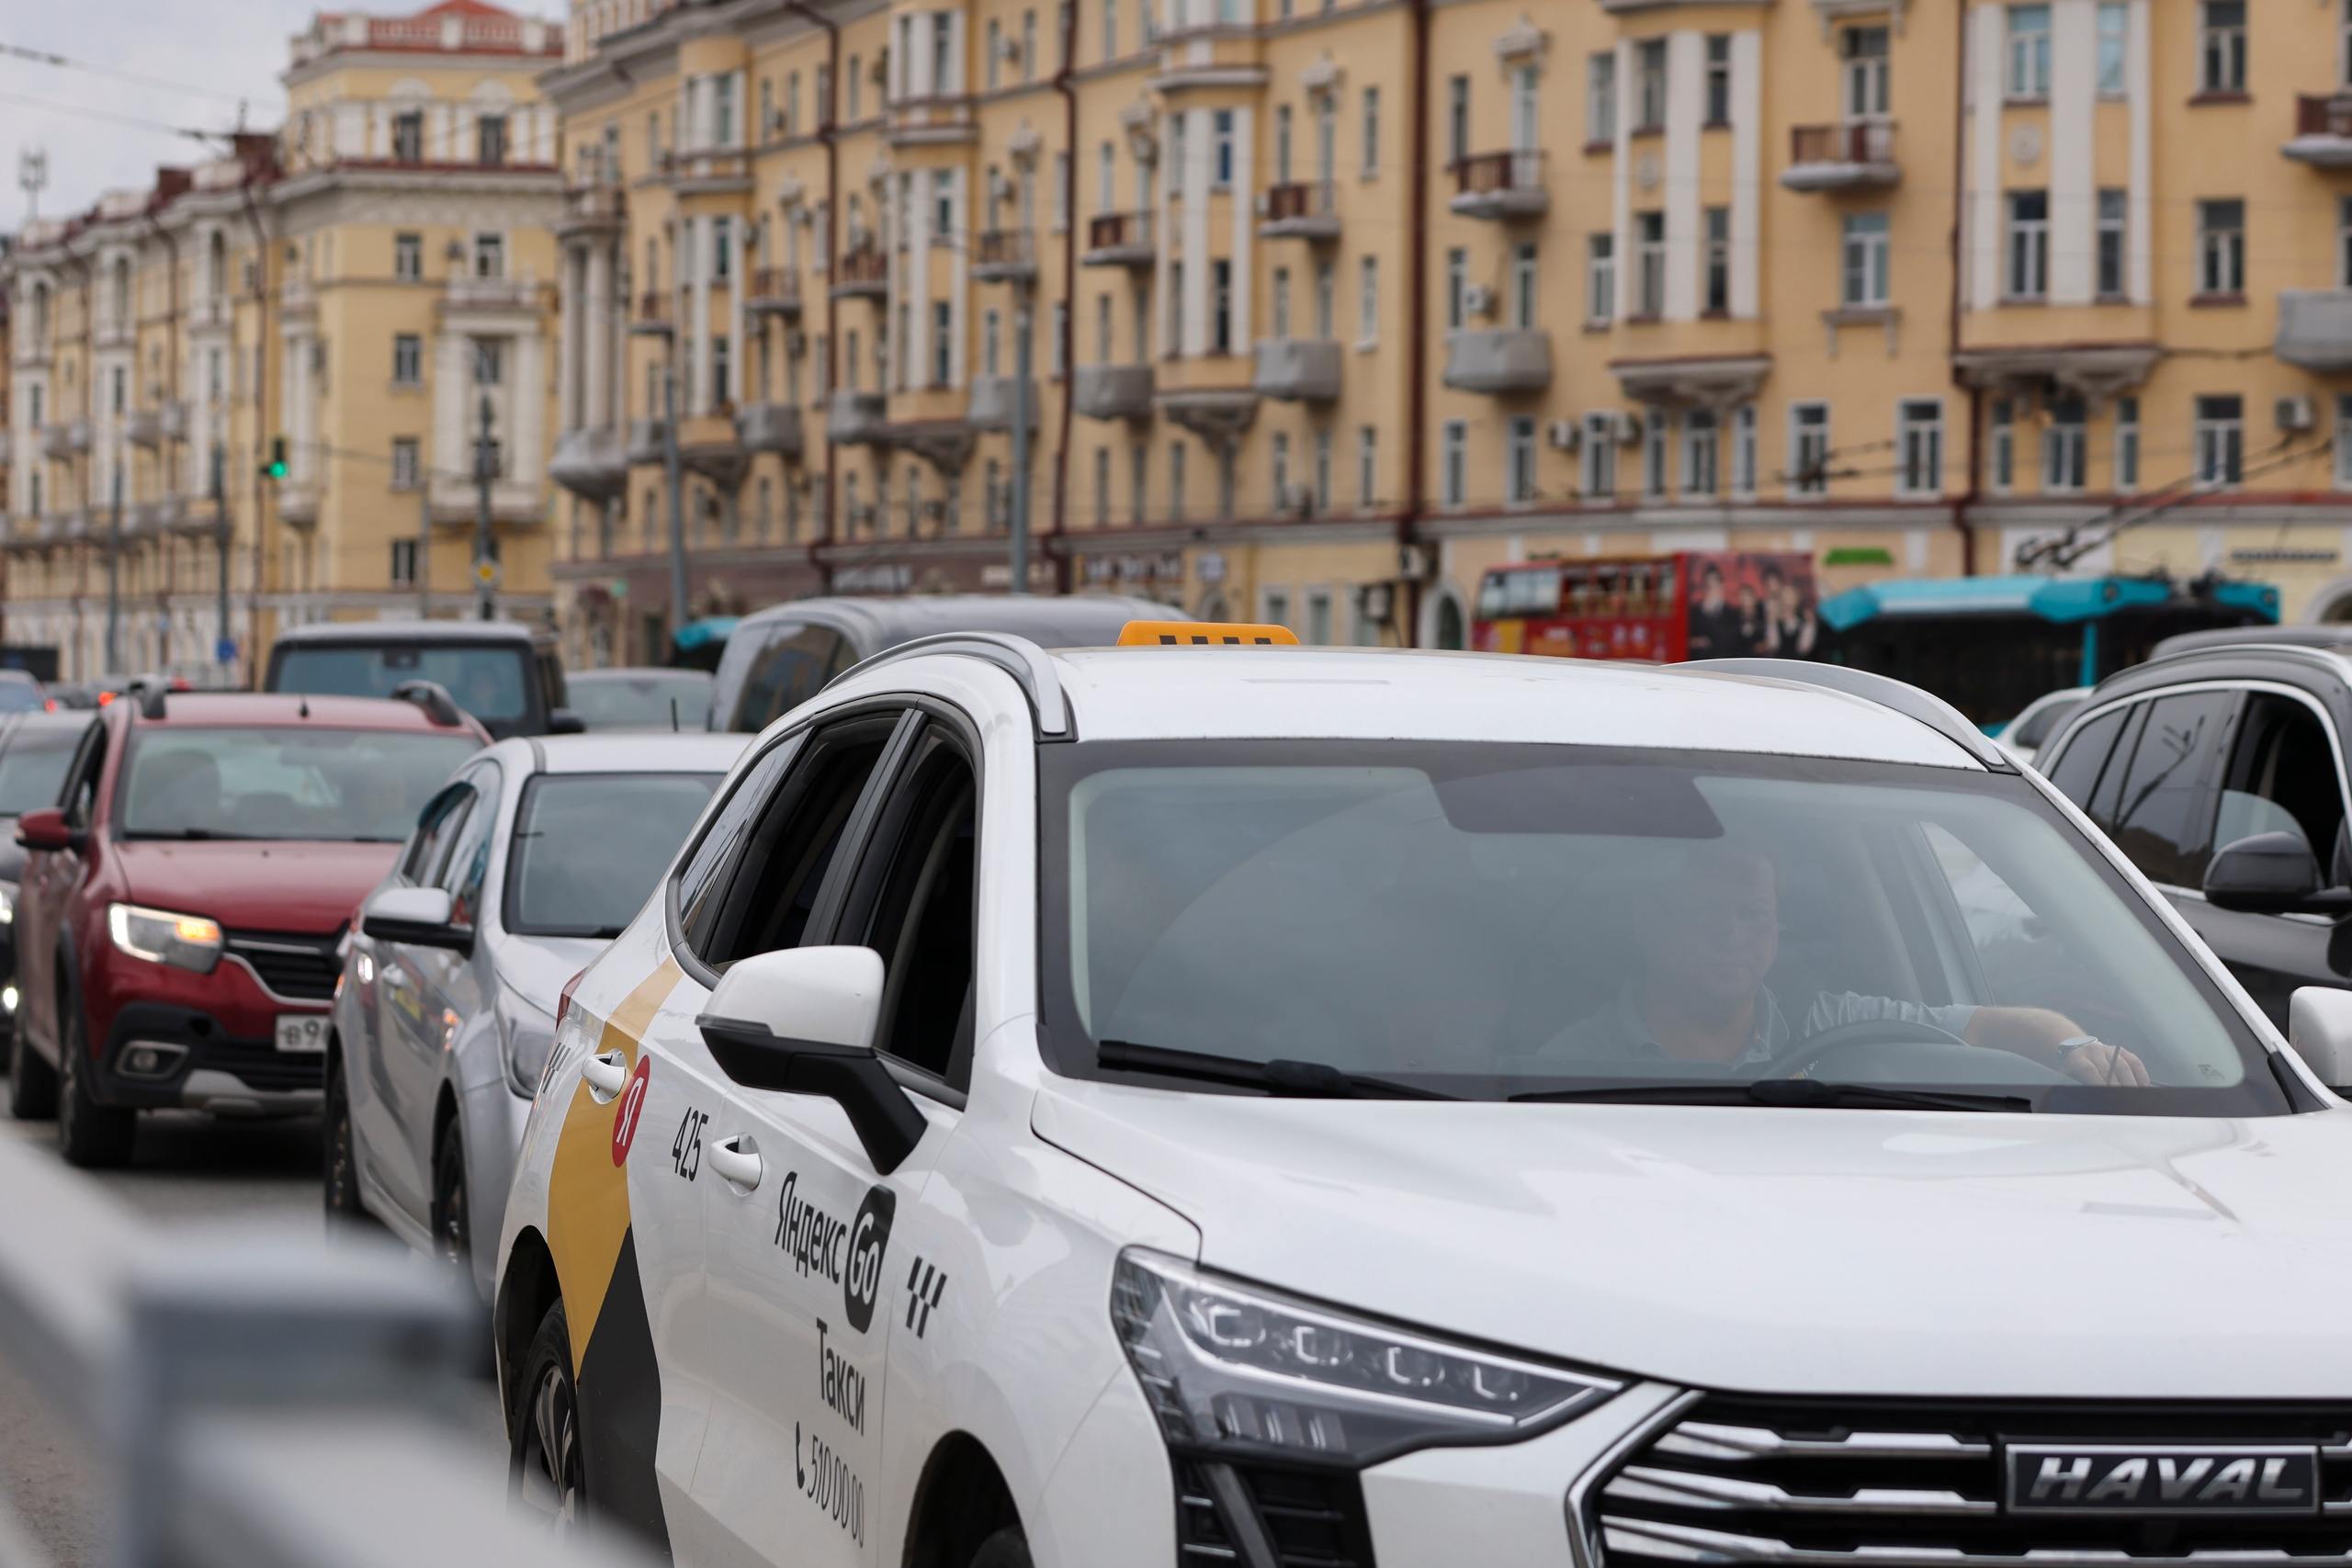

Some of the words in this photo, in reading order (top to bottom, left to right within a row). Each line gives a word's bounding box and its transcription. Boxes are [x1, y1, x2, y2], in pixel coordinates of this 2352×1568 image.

[616, 1077, 645, 1147] Я
[672, 1106, 709, 1181] 425
[774, 1170, 847, 1284] Яндекс
[850, 1211, 882, 1305] Go
[816, 1317, 865, 1438] Такси
[807, 1433, 831, 1511] 510
[832, 1454, 850, 1529] 00
[851, 1472, 865, 1549] 00
[2029, 1456, 2304, 1501] HAVAL
